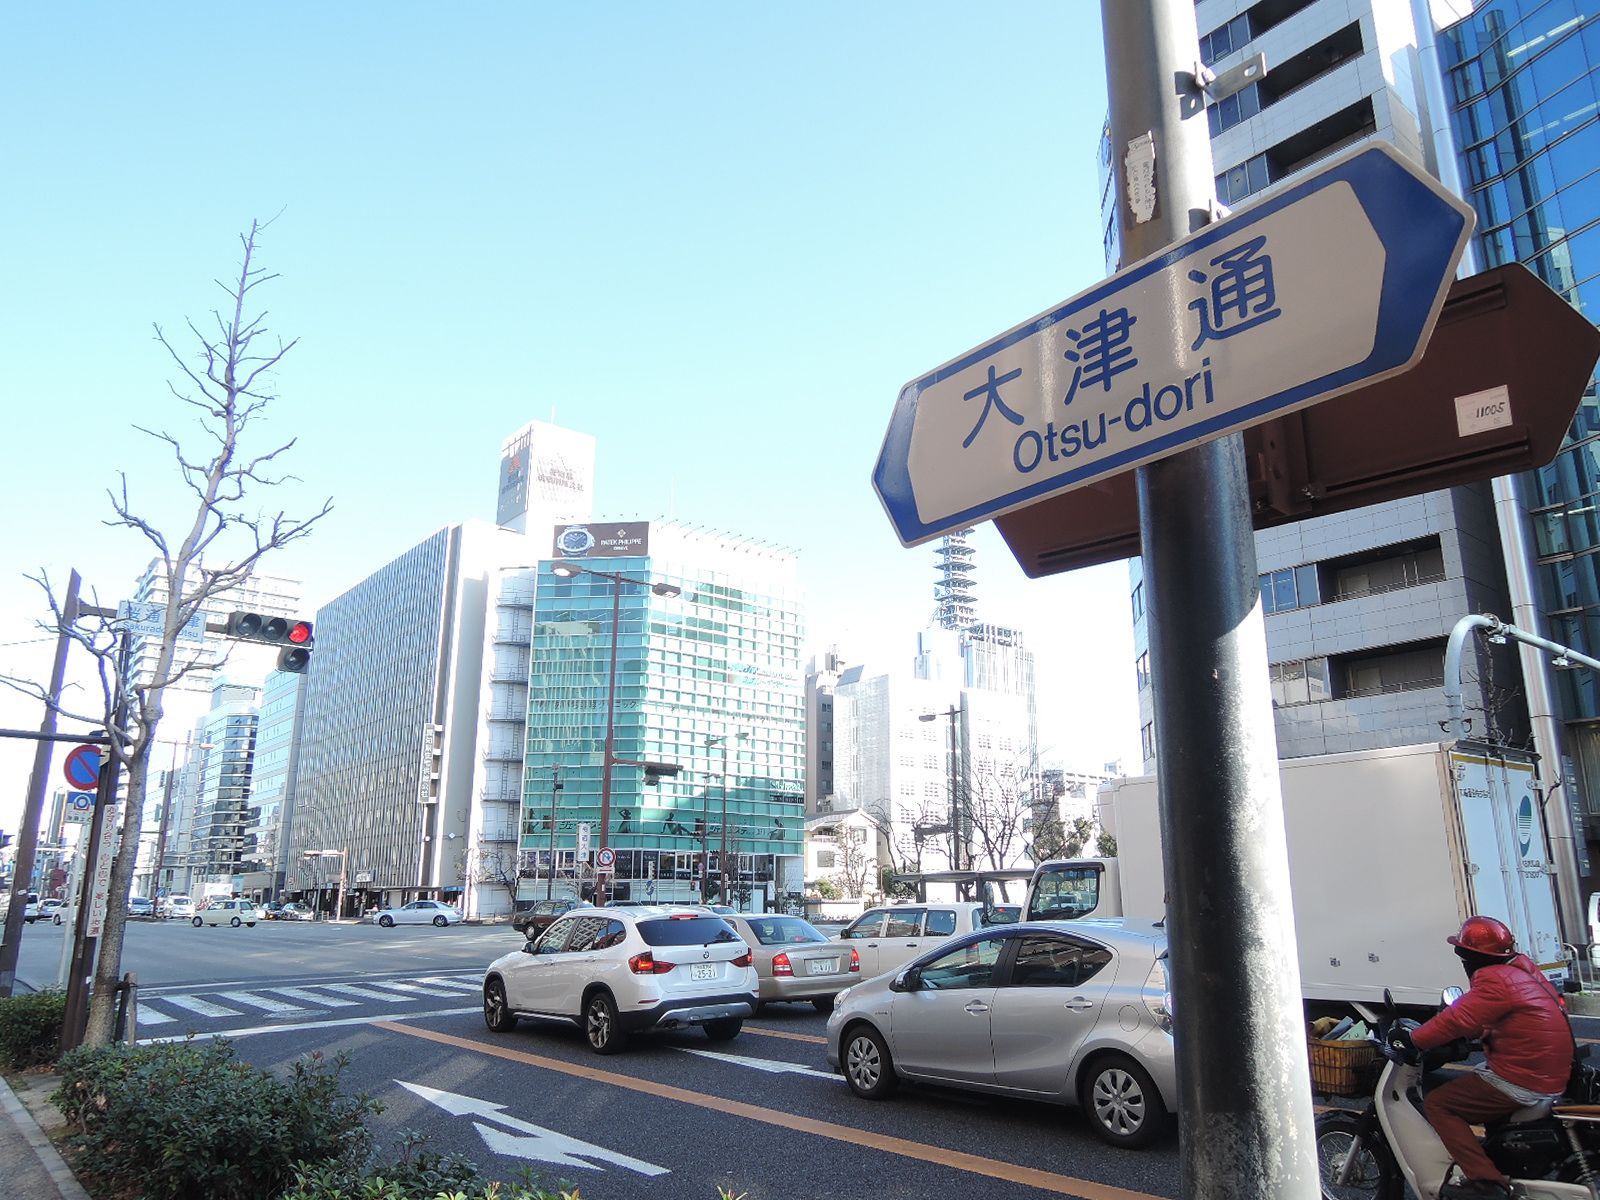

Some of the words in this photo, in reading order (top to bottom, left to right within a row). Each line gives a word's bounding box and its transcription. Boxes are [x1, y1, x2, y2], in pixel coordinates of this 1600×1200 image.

[963, 235, 1282, 449] 大津通
[1013, 357, 1214, 473] Otsu-dori
[1476, 402, 1505, 418] 11005
